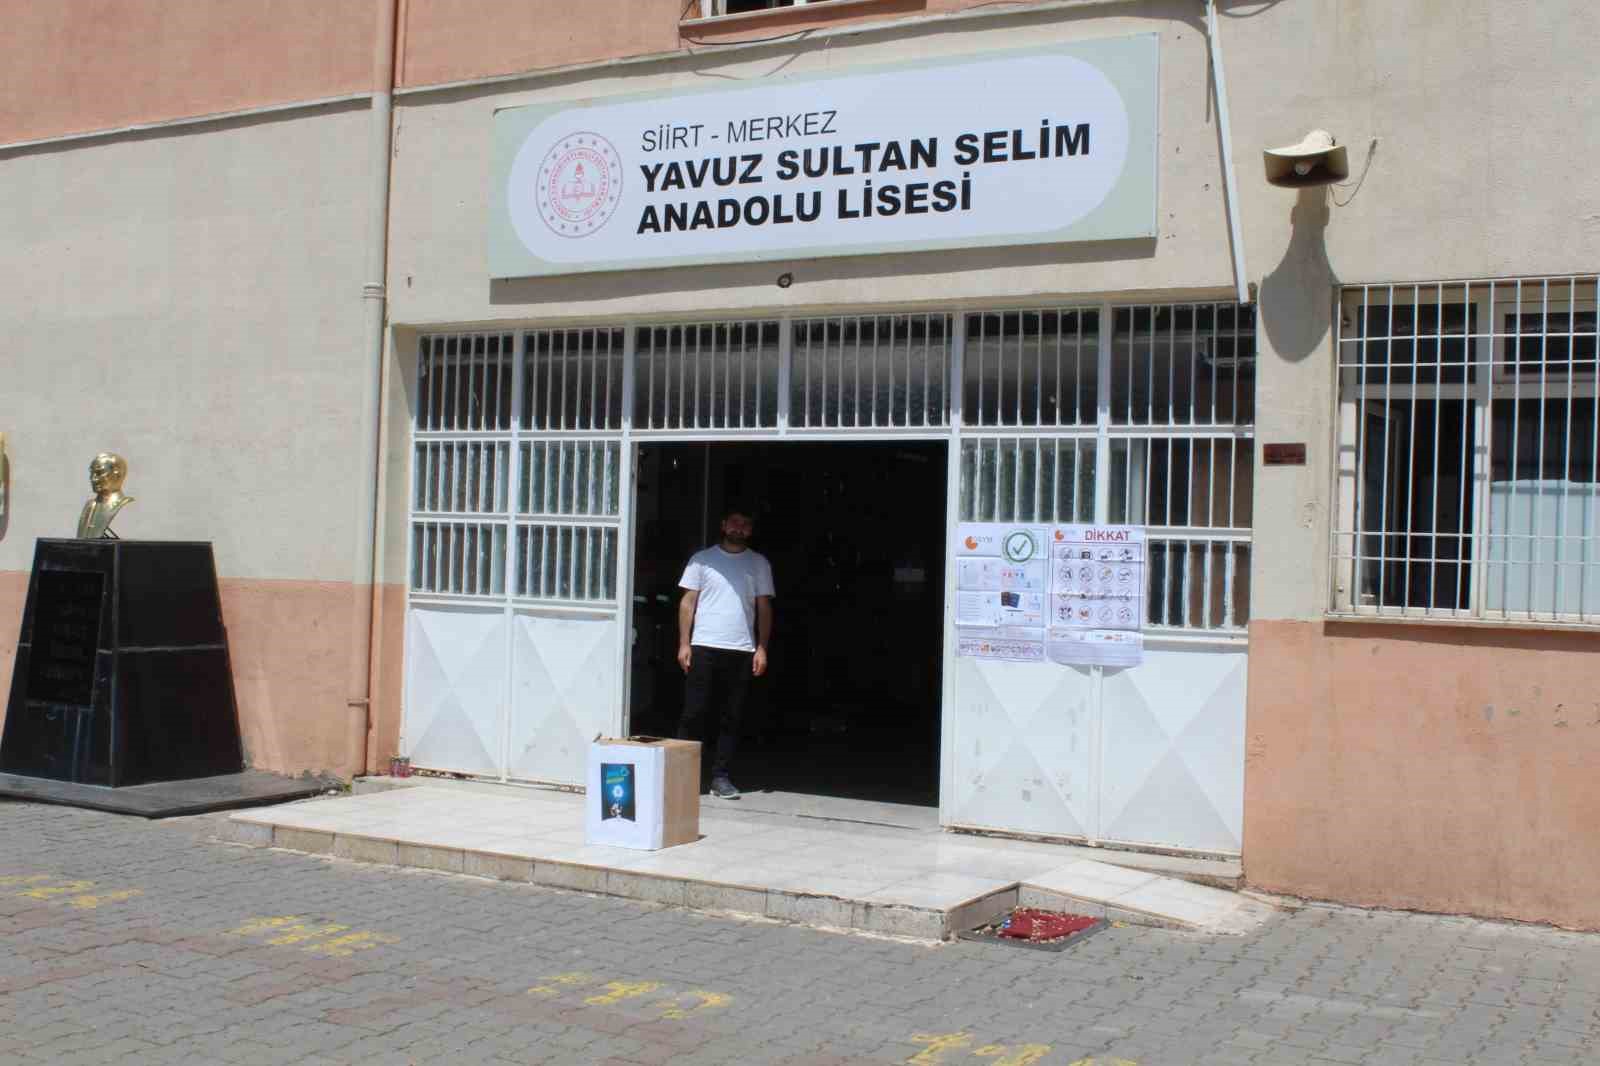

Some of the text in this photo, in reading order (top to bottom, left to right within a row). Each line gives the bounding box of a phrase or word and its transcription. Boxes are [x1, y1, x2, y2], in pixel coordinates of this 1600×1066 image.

[640, 153, 763, 192] YAVUZ
[776, 137, 938, 180] SULTAN
[954, 119, 1090, 165] SELİM
[642, 125, 704, 152] SİİRT
[727, 110, 837, 143] MERKEZ
[637, 171, 971, 234] ANADOLU LİSESİ
[1085, 528, 1130, 541] DİKKAT
